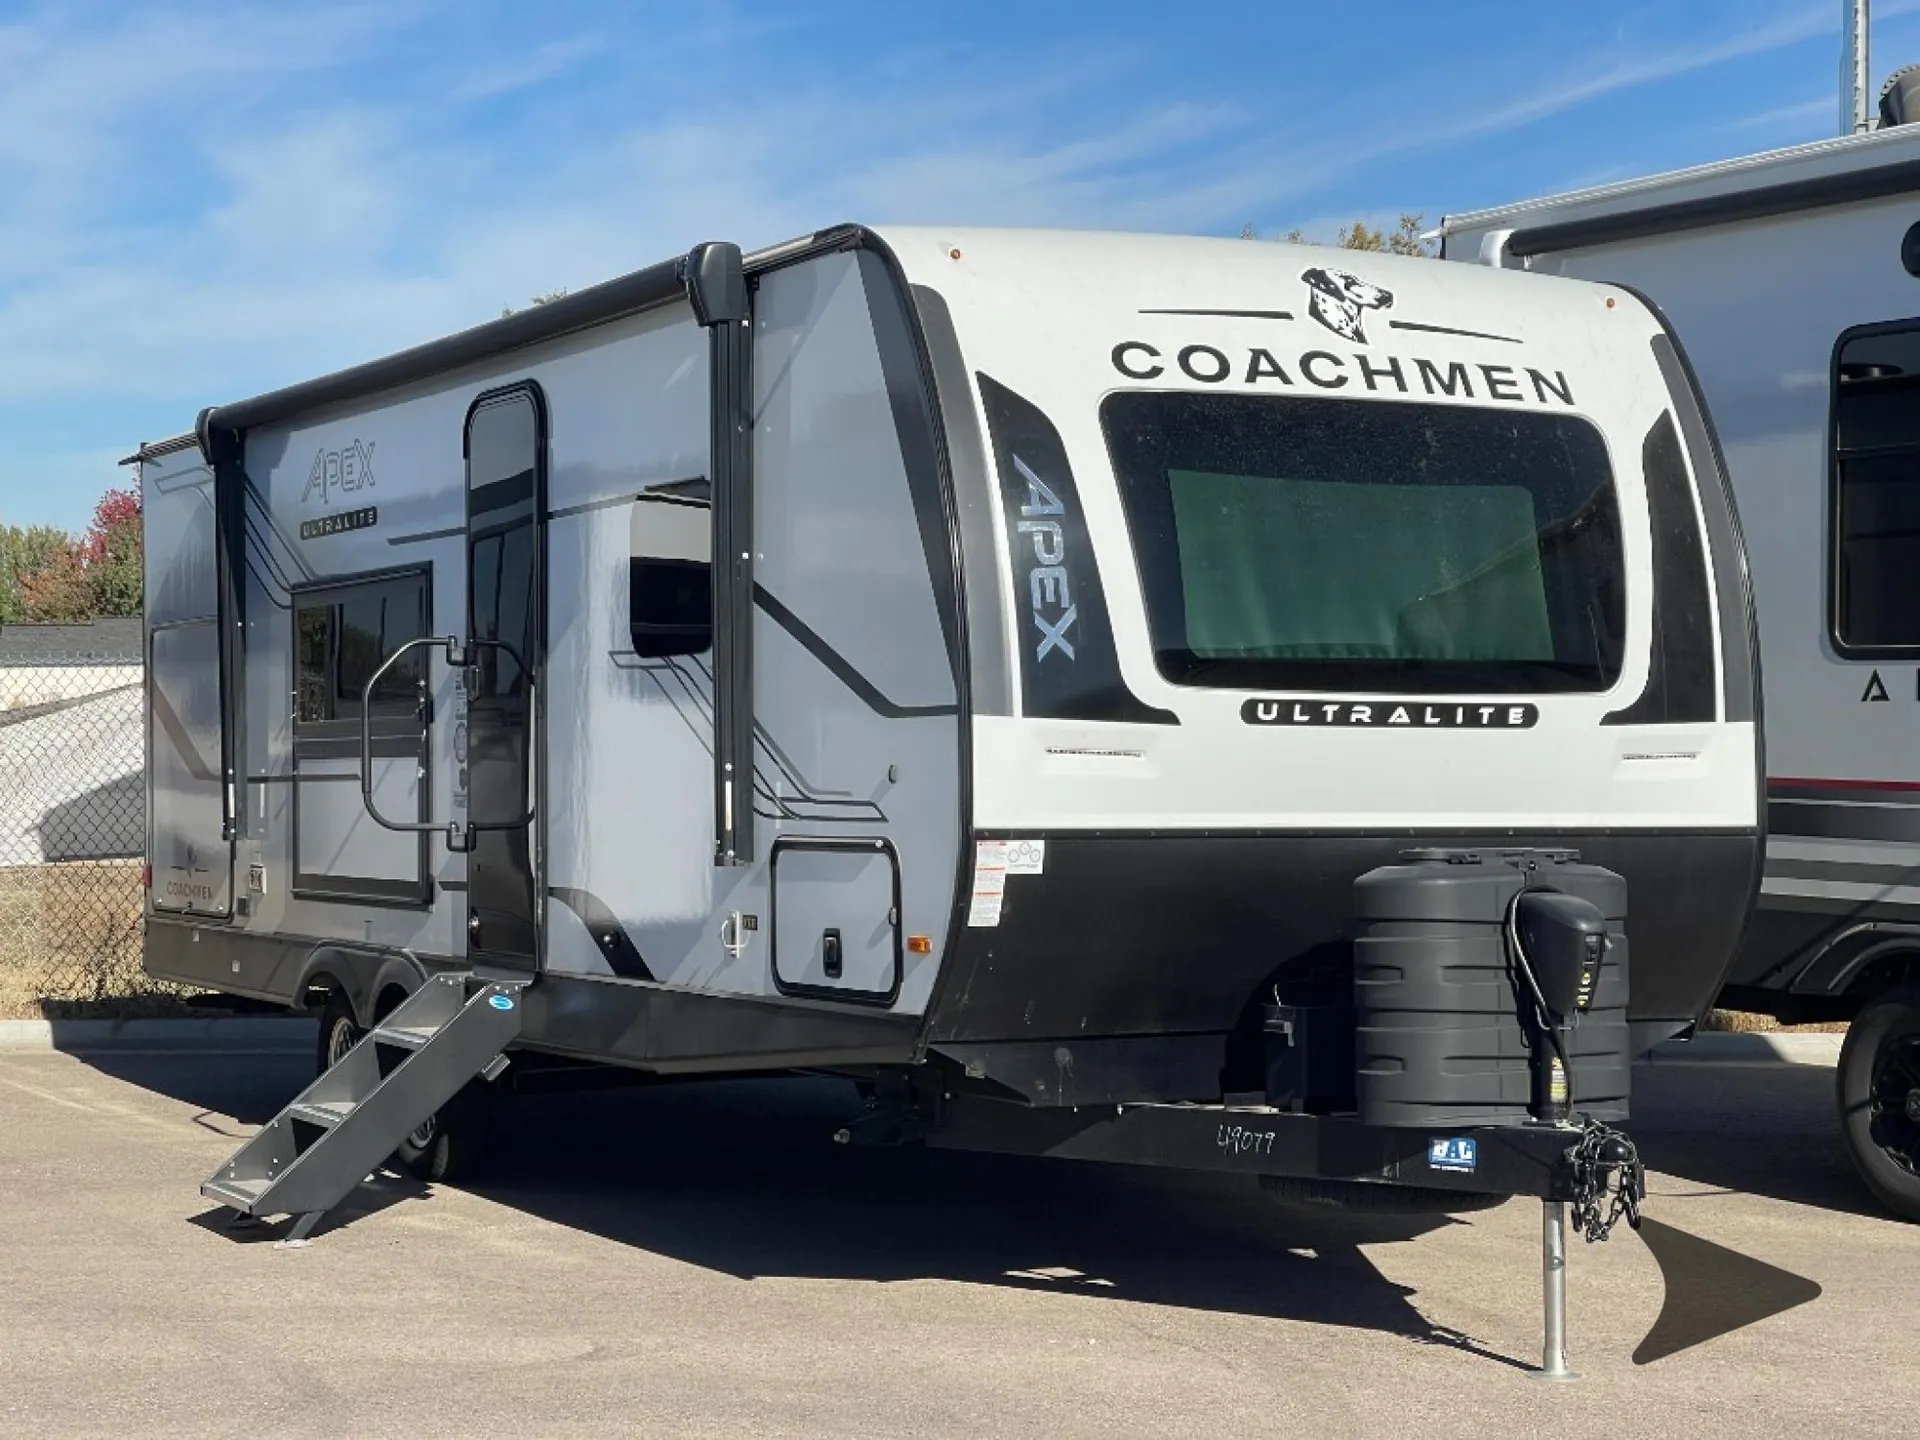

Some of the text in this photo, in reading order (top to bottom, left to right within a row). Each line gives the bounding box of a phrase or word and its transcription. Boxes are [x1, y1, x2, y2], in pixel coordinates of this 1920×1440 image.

[1111, 341, 1576, 406] COACHMEN
[302, 438, 376, 504] APEX
[303, 509, 374, 537] ULTRALITE
[1012, 453, 1077, 663] APEX
[1257, 702, 1525, 725] ULTRALITE
[1216, 1124, 1276, 1155] 49079
